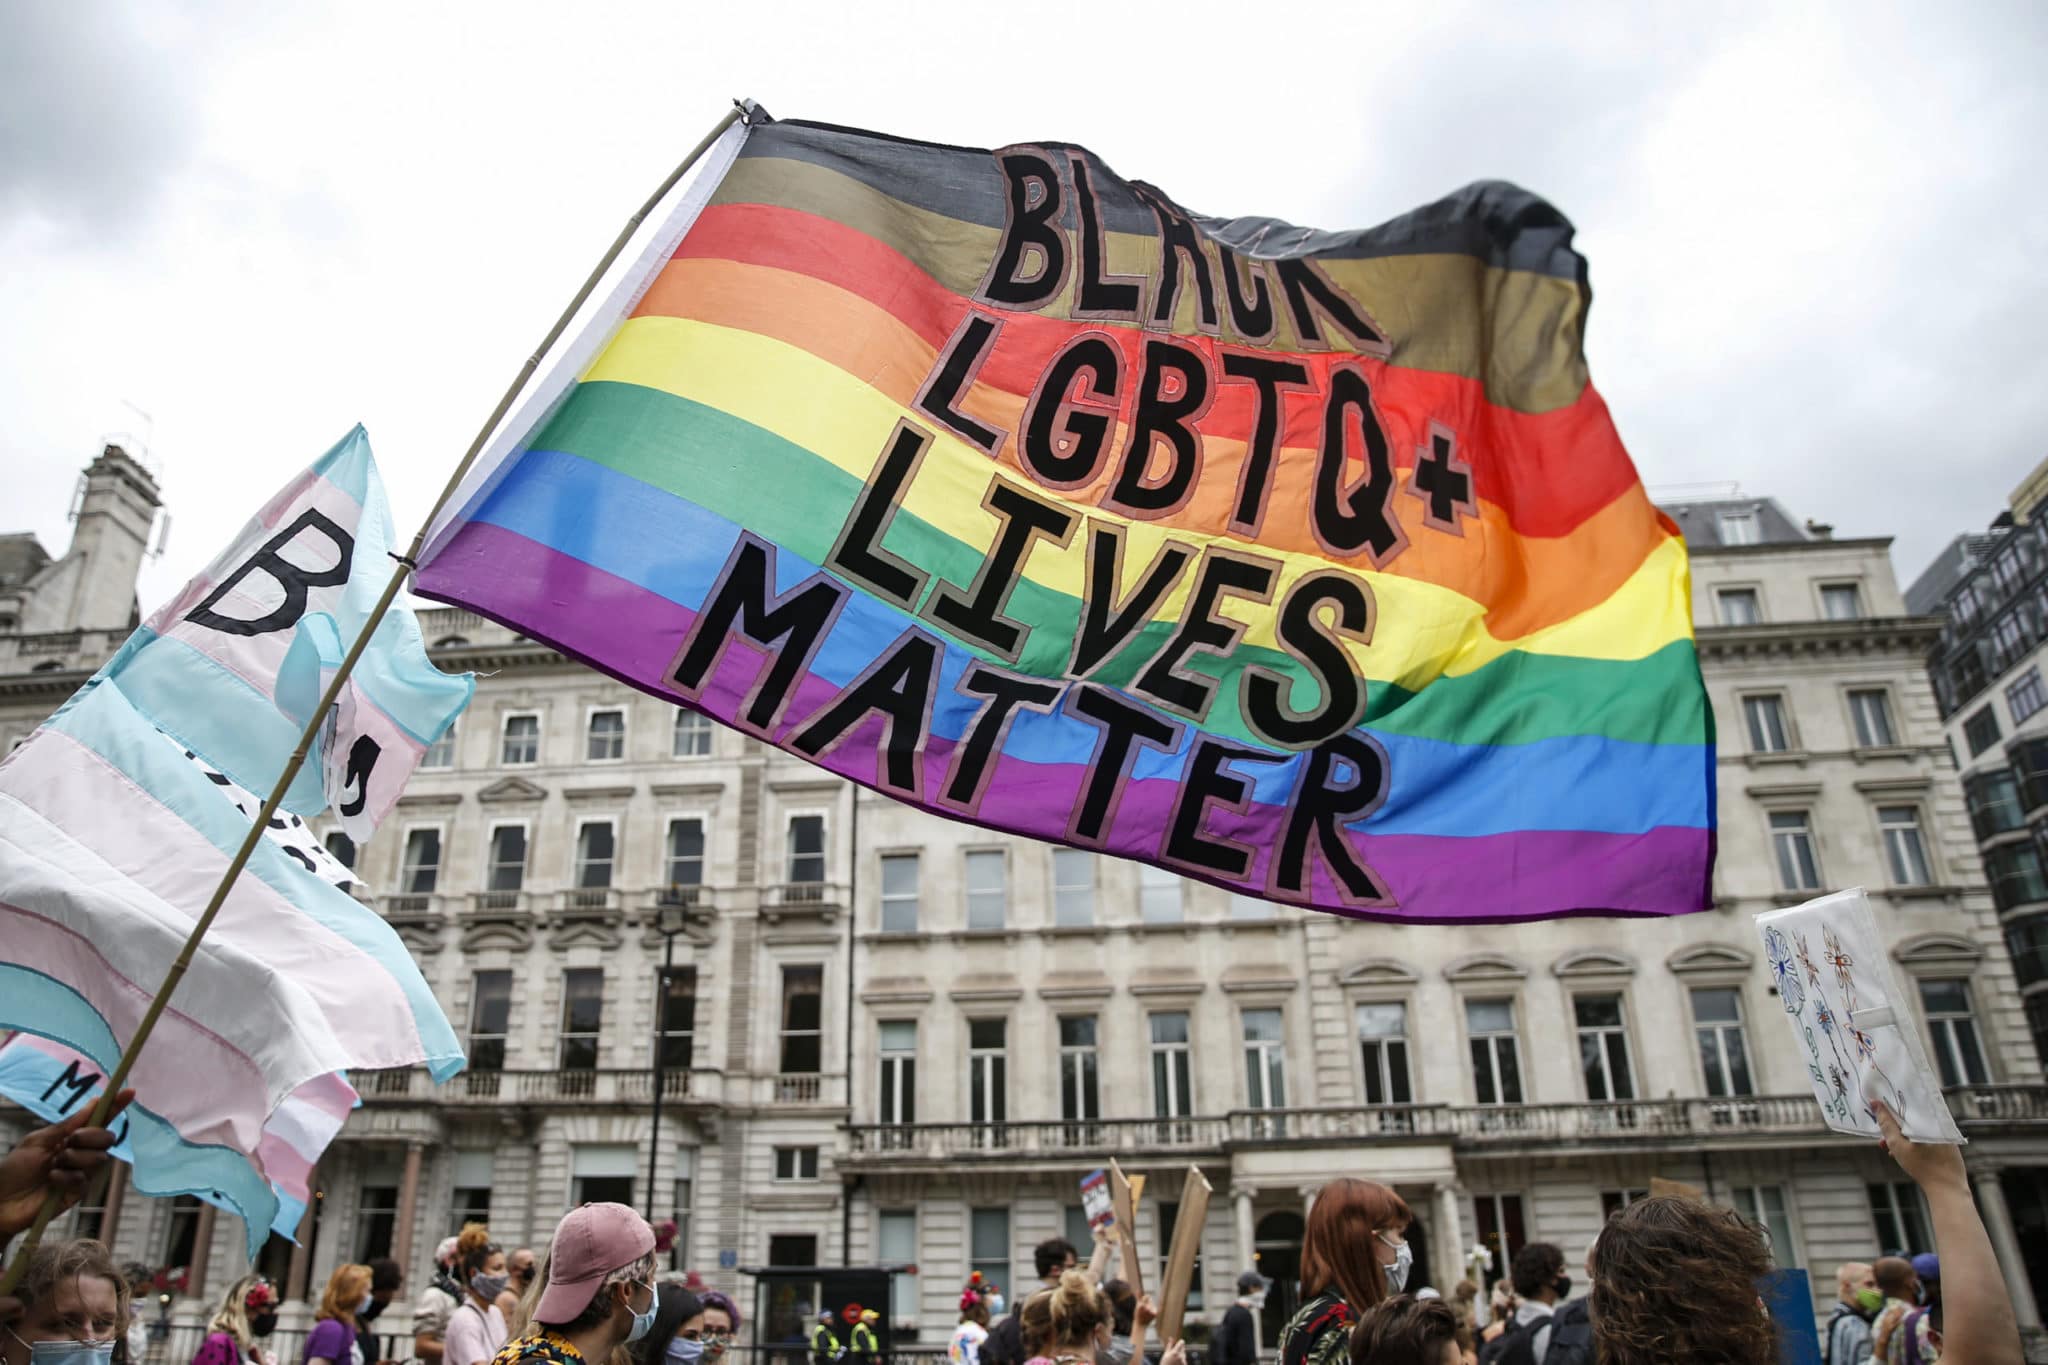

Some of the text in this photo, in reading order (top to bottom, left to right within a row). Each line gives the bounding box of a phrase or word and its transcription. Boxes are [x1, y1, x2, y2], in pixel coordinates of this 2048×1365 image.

[976, 146, 1390, 354] BLACK
[826, 420, 1374, 748] LIVES
[916, 310, 1476, 566] LGBTQ+
[666, 533, 1394, 905] MATTER
